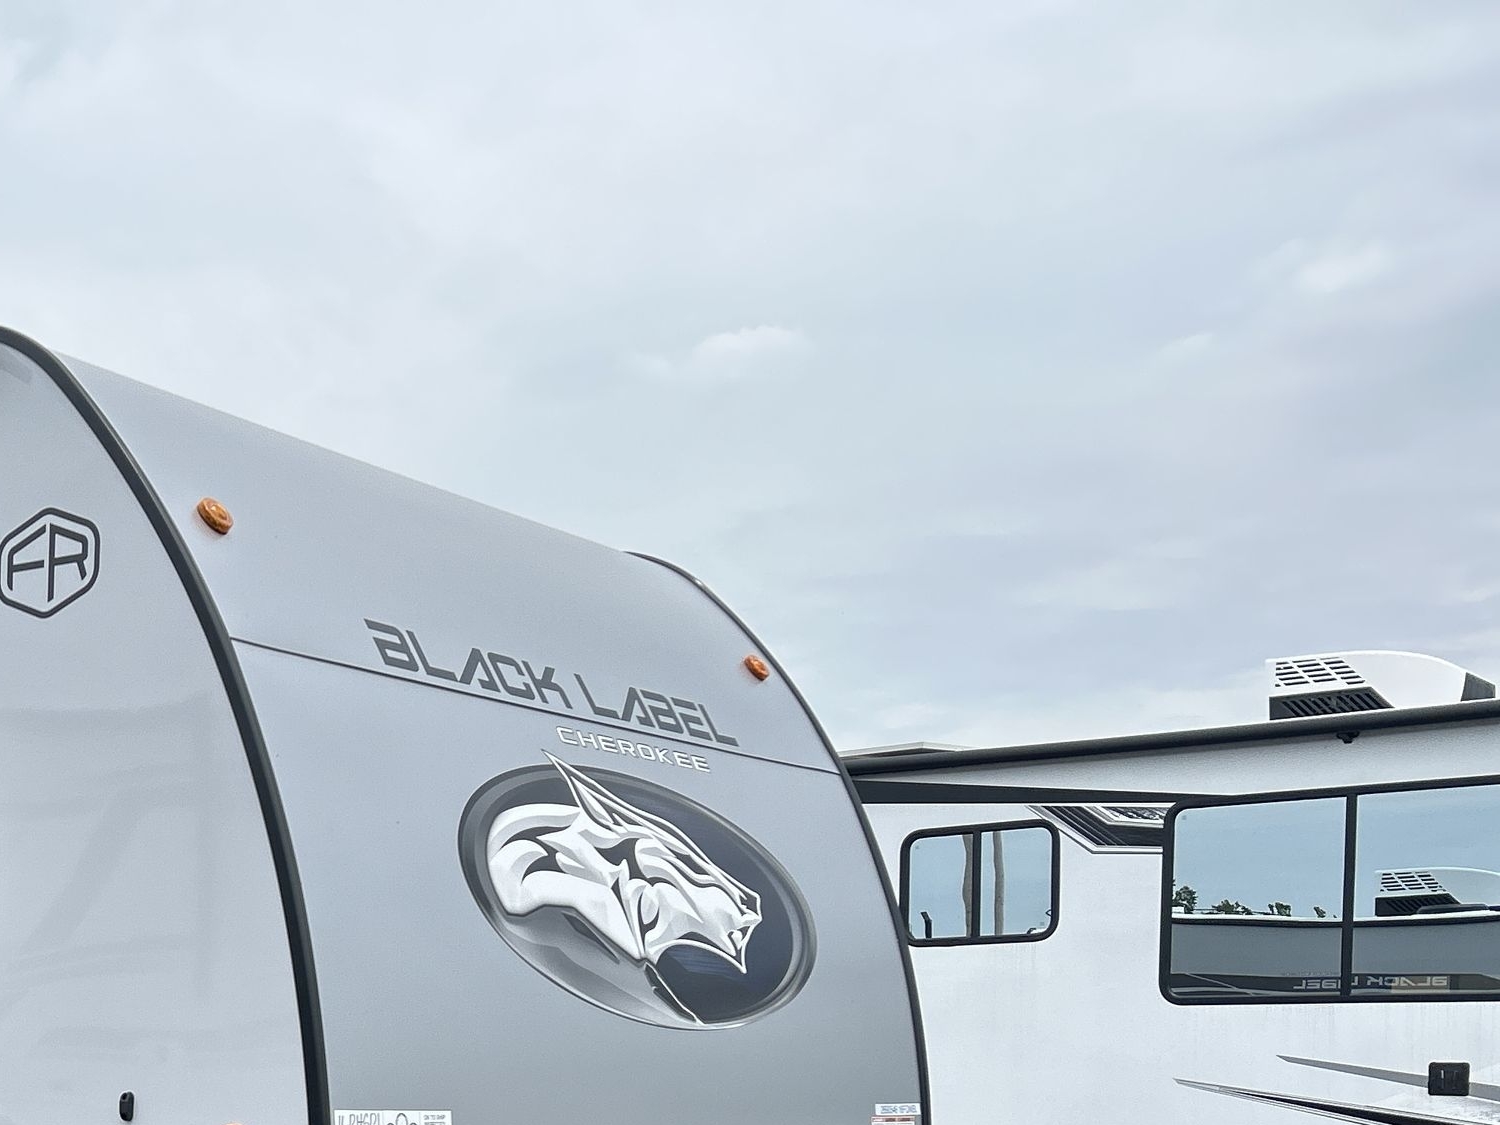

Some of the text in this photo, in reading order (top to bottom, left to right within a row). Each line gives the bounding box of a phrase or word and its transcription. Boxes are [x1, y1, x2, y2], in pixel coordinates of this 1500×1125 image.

[363, 617, 740, 747] BLACK LABEL
[556, 725, 711, 773] CHEROKEE
